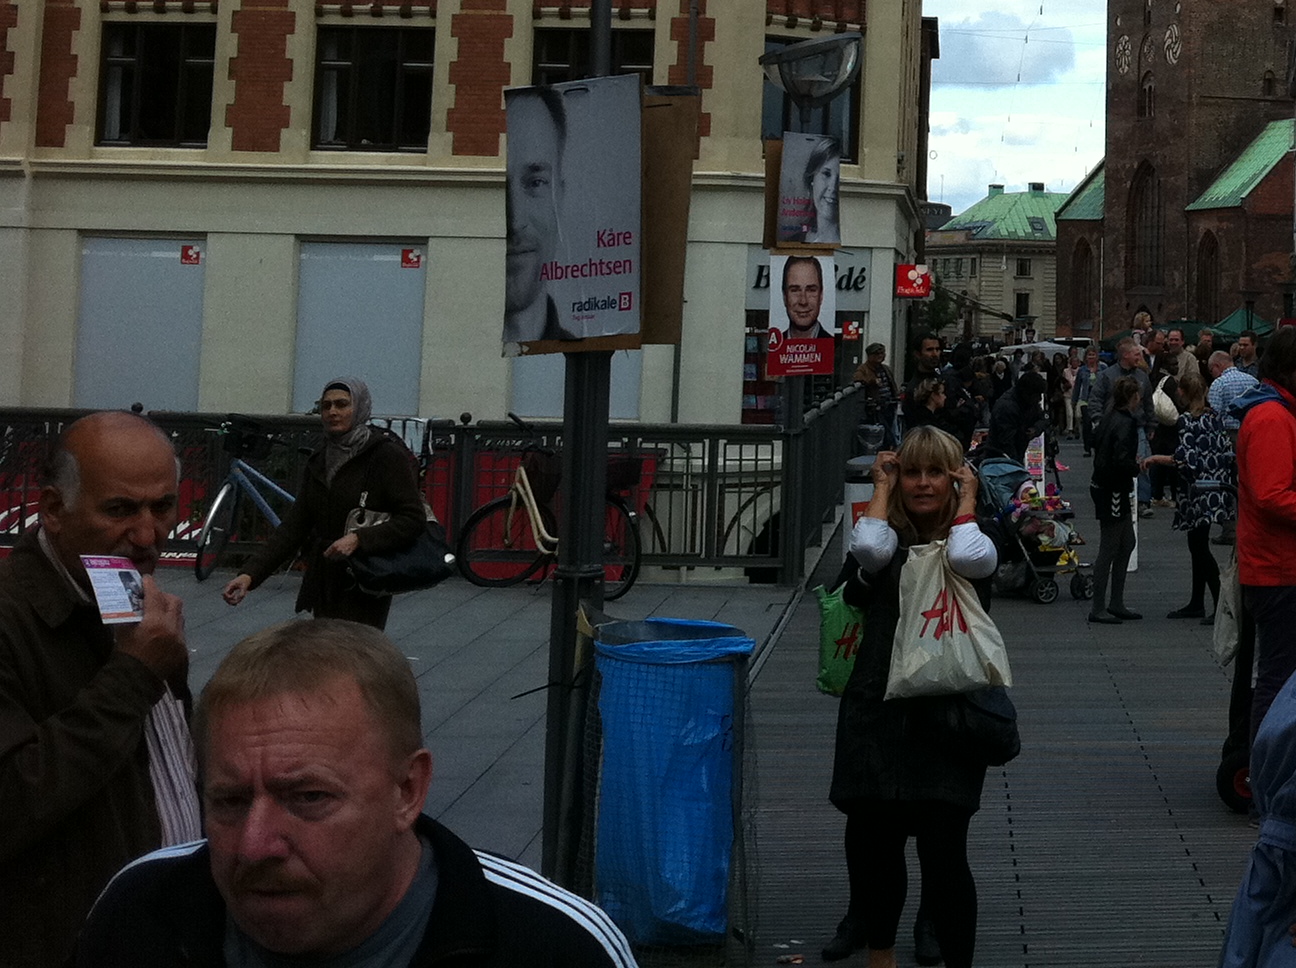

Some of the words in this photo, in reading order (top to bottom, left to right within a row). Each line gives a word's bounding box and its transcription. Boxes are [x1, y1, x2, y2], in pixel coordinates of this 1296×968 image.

[597, 228, 632, 248] Kåre
[540, 258, 632, 281] Albrechtsen
[571, 295, 618, 312] radikale
[620, 293, 631, 310] B
[768, 332, 778, 344] A
[786, 343, 817, 353] NICOLAI
[779, 353, 822, 364] WAMMEN
